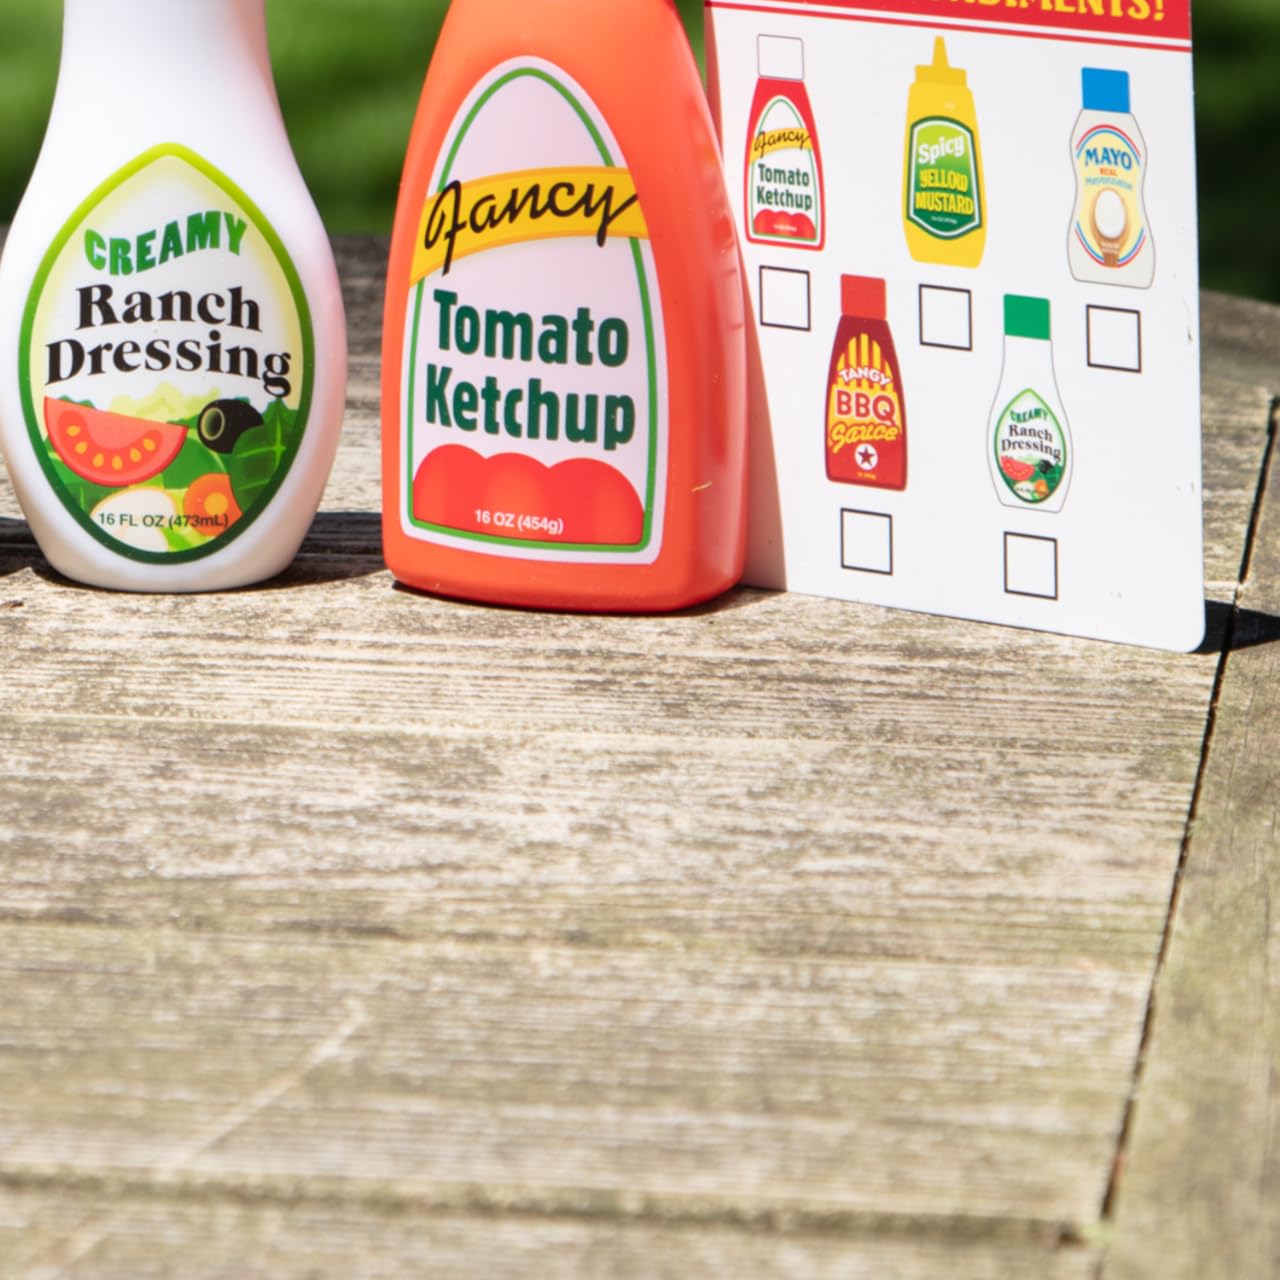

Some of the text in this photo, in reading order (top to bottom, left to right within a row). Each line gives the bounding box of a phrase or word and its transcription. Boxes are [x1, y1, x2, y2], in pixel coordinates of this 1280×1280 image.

[753, 131, 810, 159] Fancy
[918, 136, 964, 165] Spicy
[1084, 147, 1132, 170] MAYO
[758, 163, 810, 187] Tomato
[919, 169, 968, 192] YELLOW
[756, 186, 813, 211] Ketchup
[915, 192, 974, 215] MUSTARD
[425, 179, 639, 276] Fancy
[84, 210, 248, 276] CREAMY
[75, 283, 262, 331] Ranch
[433, 288, 629, 367] Tomato
[45, 330, 291, 397] Dressing
[839, 367, 891, 385] TANGY
[426, 363, 636, 450] Ketchup
[836, 388, 897, 426] BBQ
[831, 423, 897, 454] Sauce
[1008, 424, 1053, 442] Ranch
[1001, 439, 1061, 463] Dressing
[99, 513, 230, 530] 16 FL OZ (473mL)
[475, 509, 564, 535] 16 OZ (454g)
